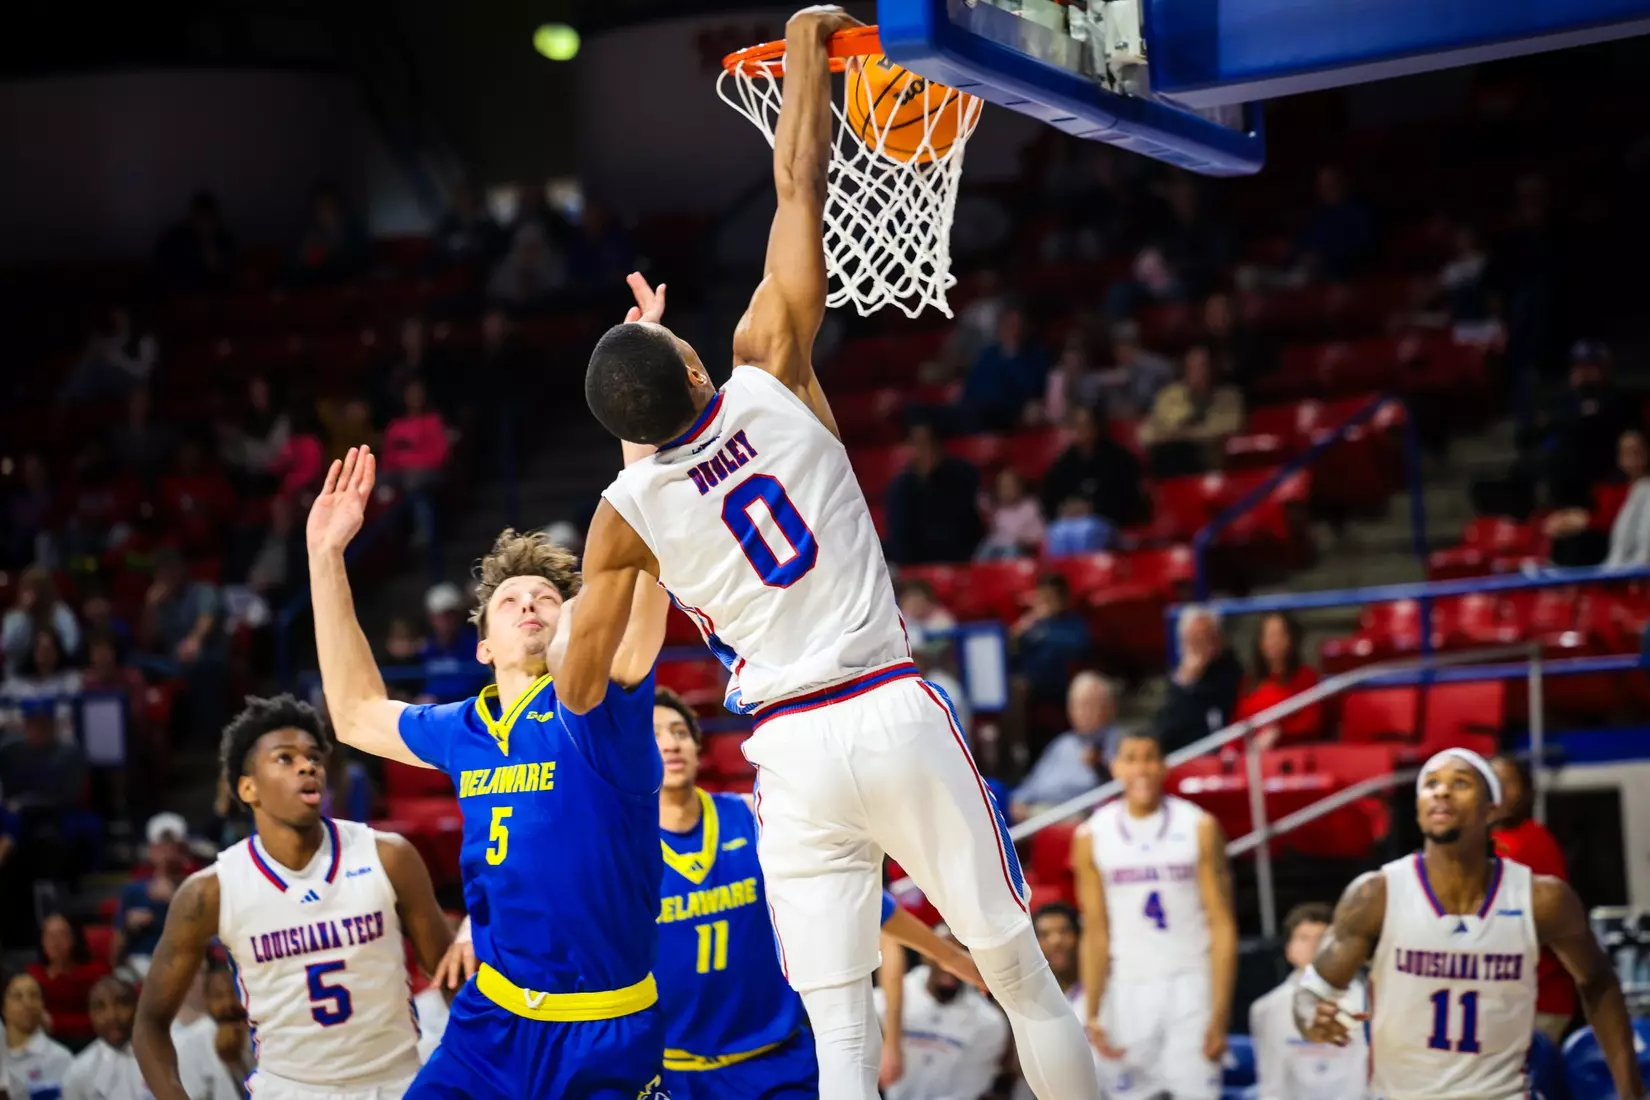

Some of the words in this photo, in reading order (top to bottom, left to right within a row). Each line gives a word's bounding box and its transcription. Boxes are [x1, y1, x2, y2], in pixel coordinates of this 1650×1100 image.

[687, 429, 758, 496] DUDLEY
[721, 473, 819, 589] 0
[459, 761, 556, 798] DELAWARE
[485, 806, 513, 866] 5
[655, 877, 757, 924] ELAWARE
[1143, 890, 1167, 930] 4
[250, 920, 342, 963] LOUISIANA
[341, 910, 383, 946] TECH
[695, 919, 728, 974] 11
[1396, 948, 1479, 980] LOUISIANA
[1483, 953, 1523, 980] TECH
[305, 959, 353, 1027] 5
[1427, 988, 1481, 1054] 11
